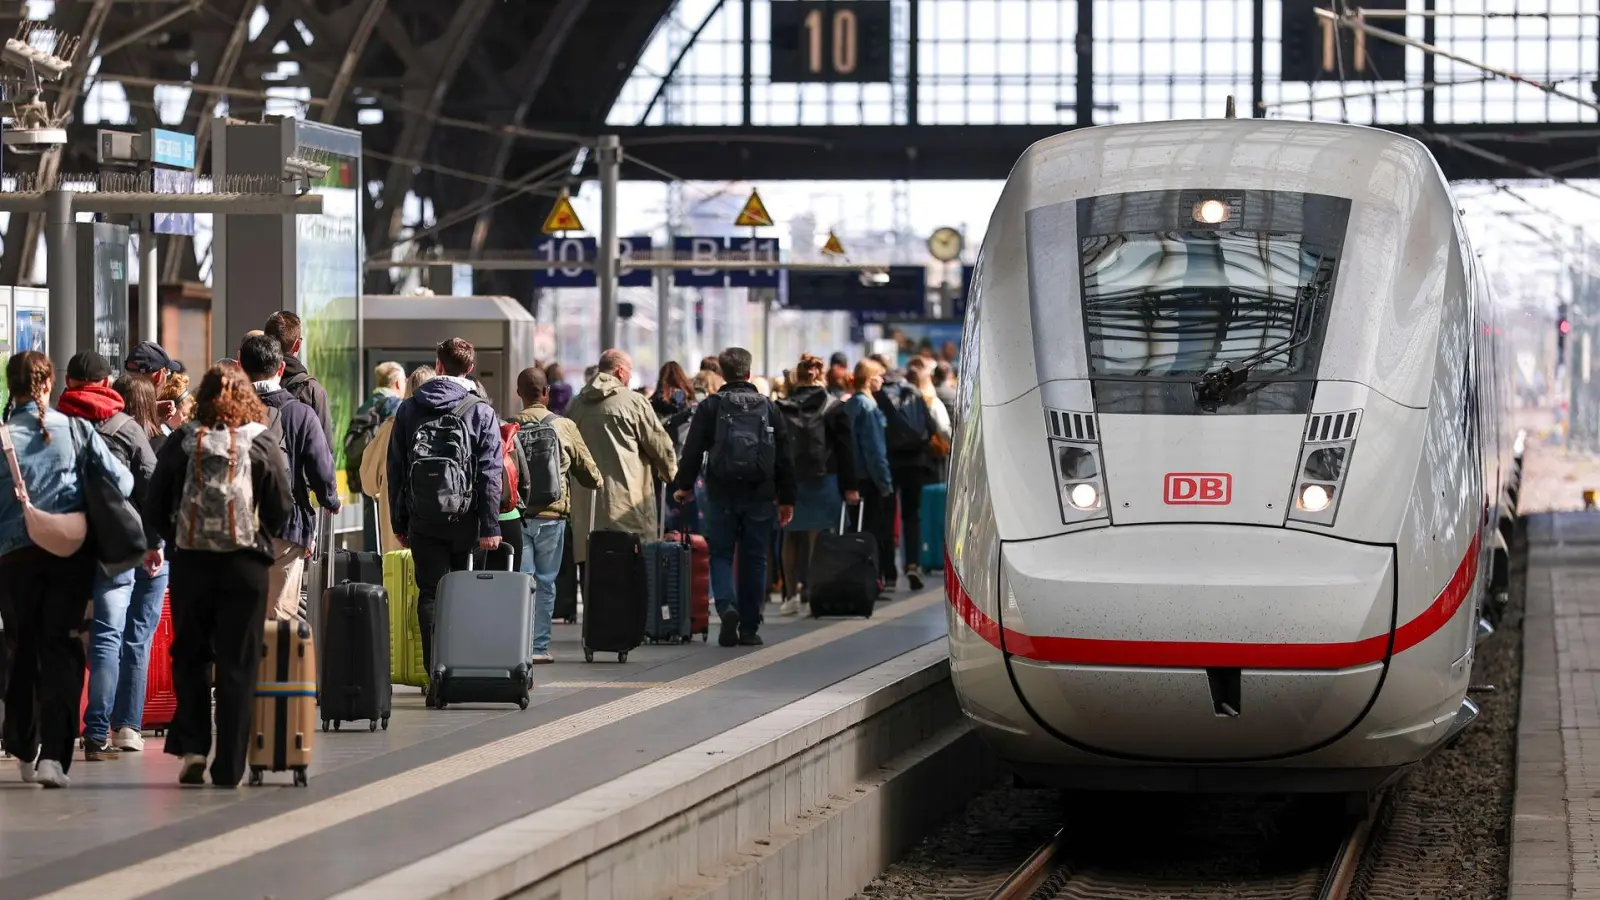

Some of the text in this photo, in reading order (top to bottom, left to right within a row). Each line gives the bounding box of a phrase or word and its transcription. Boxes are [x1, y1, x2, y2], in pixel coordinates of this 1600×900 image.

[804, 8, 857, 74] 10
[1318, 9, 1366, 72] 11
[538, 238, 584, 278] 10
[691, 238, 777, 277] B 11
[1172, 477, 1224, 500] DB
